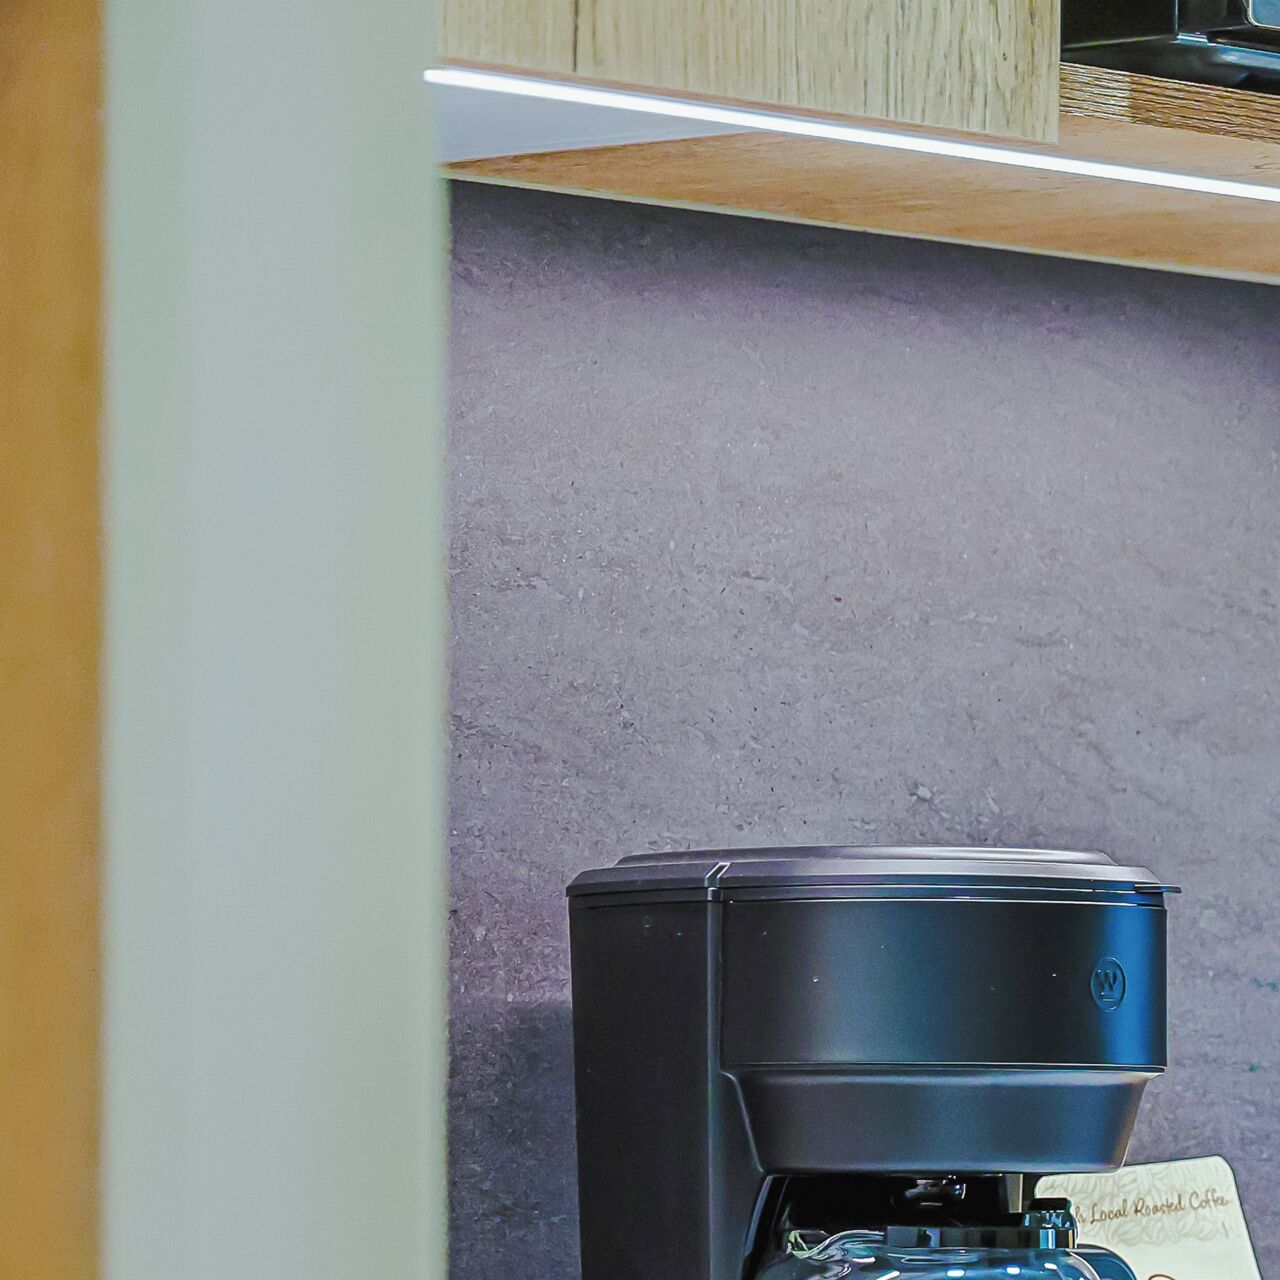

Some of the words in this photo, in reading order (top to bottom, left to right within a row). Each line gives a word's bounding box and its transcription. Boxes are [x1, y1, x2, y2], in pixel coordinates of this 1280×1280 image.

[1090, 1199, 1128, 1224] Local
[1133, 1193, 1185, 1217] Roasted
[1189, 1188, 1229, 1212] Coffee
